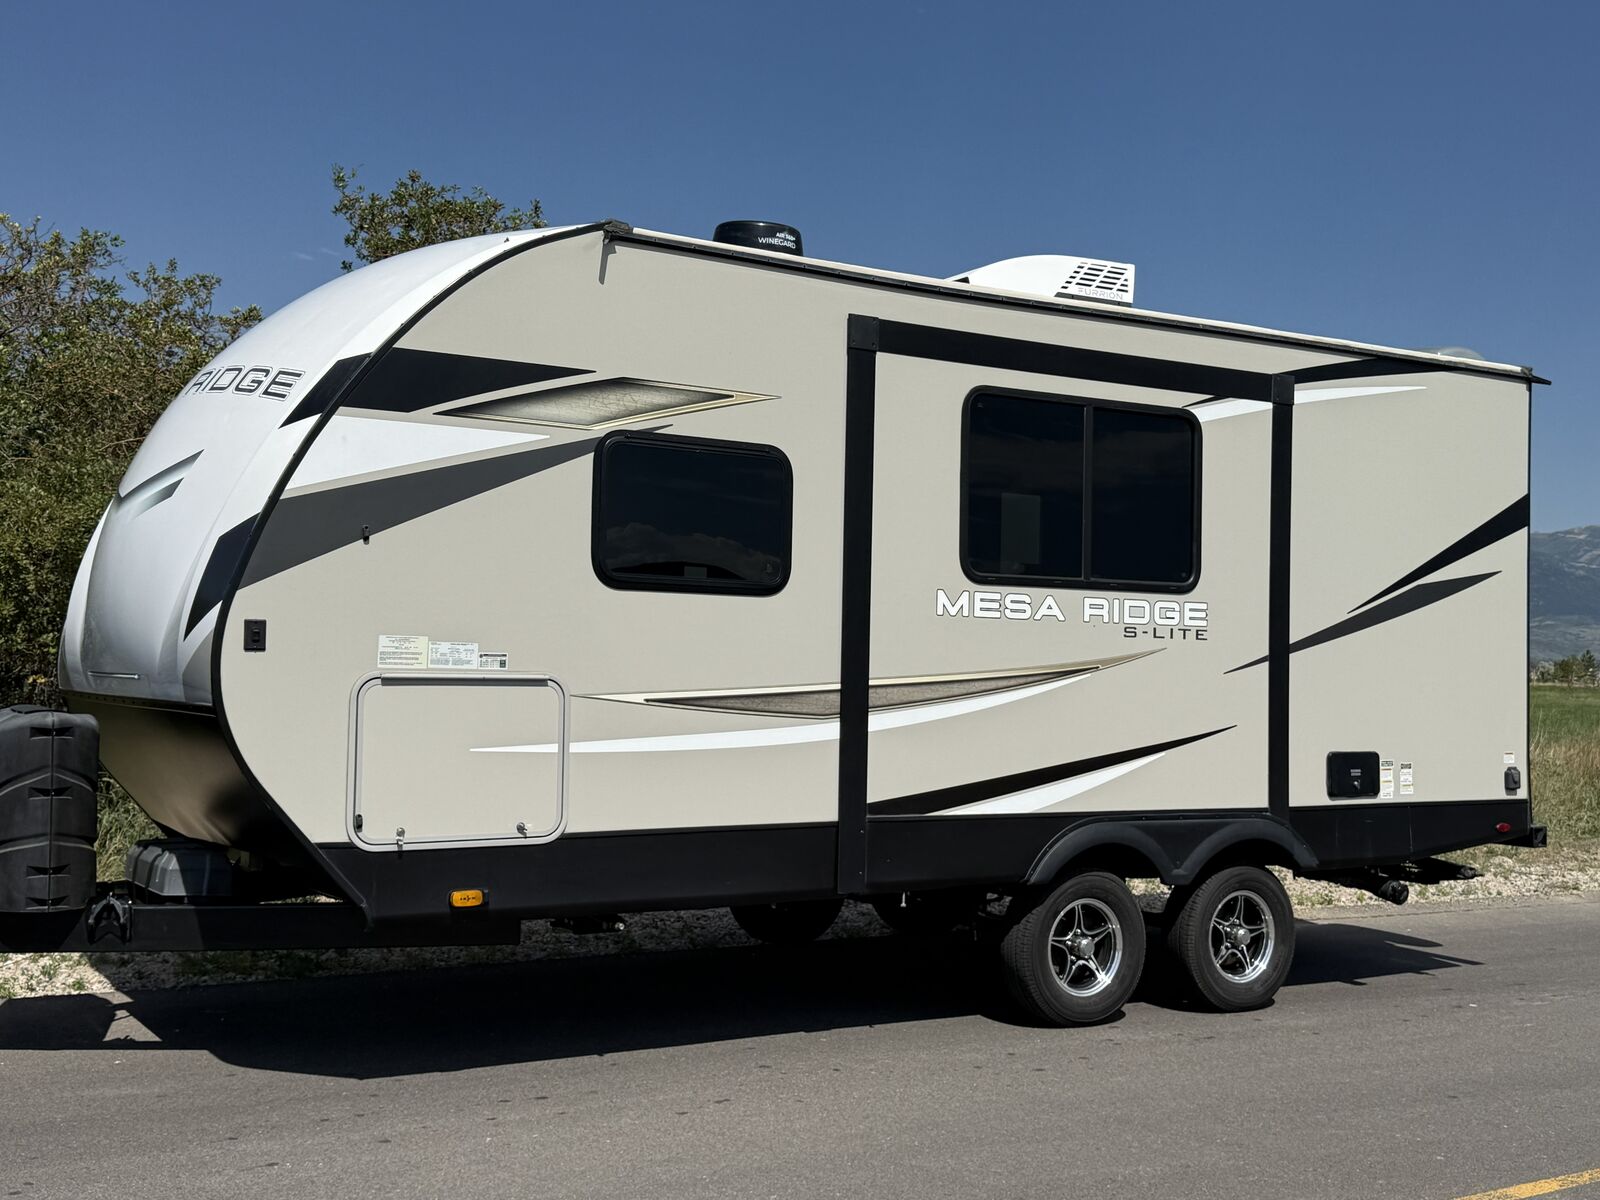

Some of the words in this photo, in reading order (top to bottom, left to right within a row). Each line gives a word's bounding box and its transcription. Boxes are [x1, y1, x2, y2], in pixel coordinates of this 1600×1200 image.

[757, 236, 796, 249] WINEGARD
[1077, 287, 1124, 300] FURRION
[184, 365, 306, 401] RIDGE
[936, 588, 1066, 622] MESA
[1083, 596, 1209, 627] RIDGE
[1123, 626, 1208, 641] S-LITE
